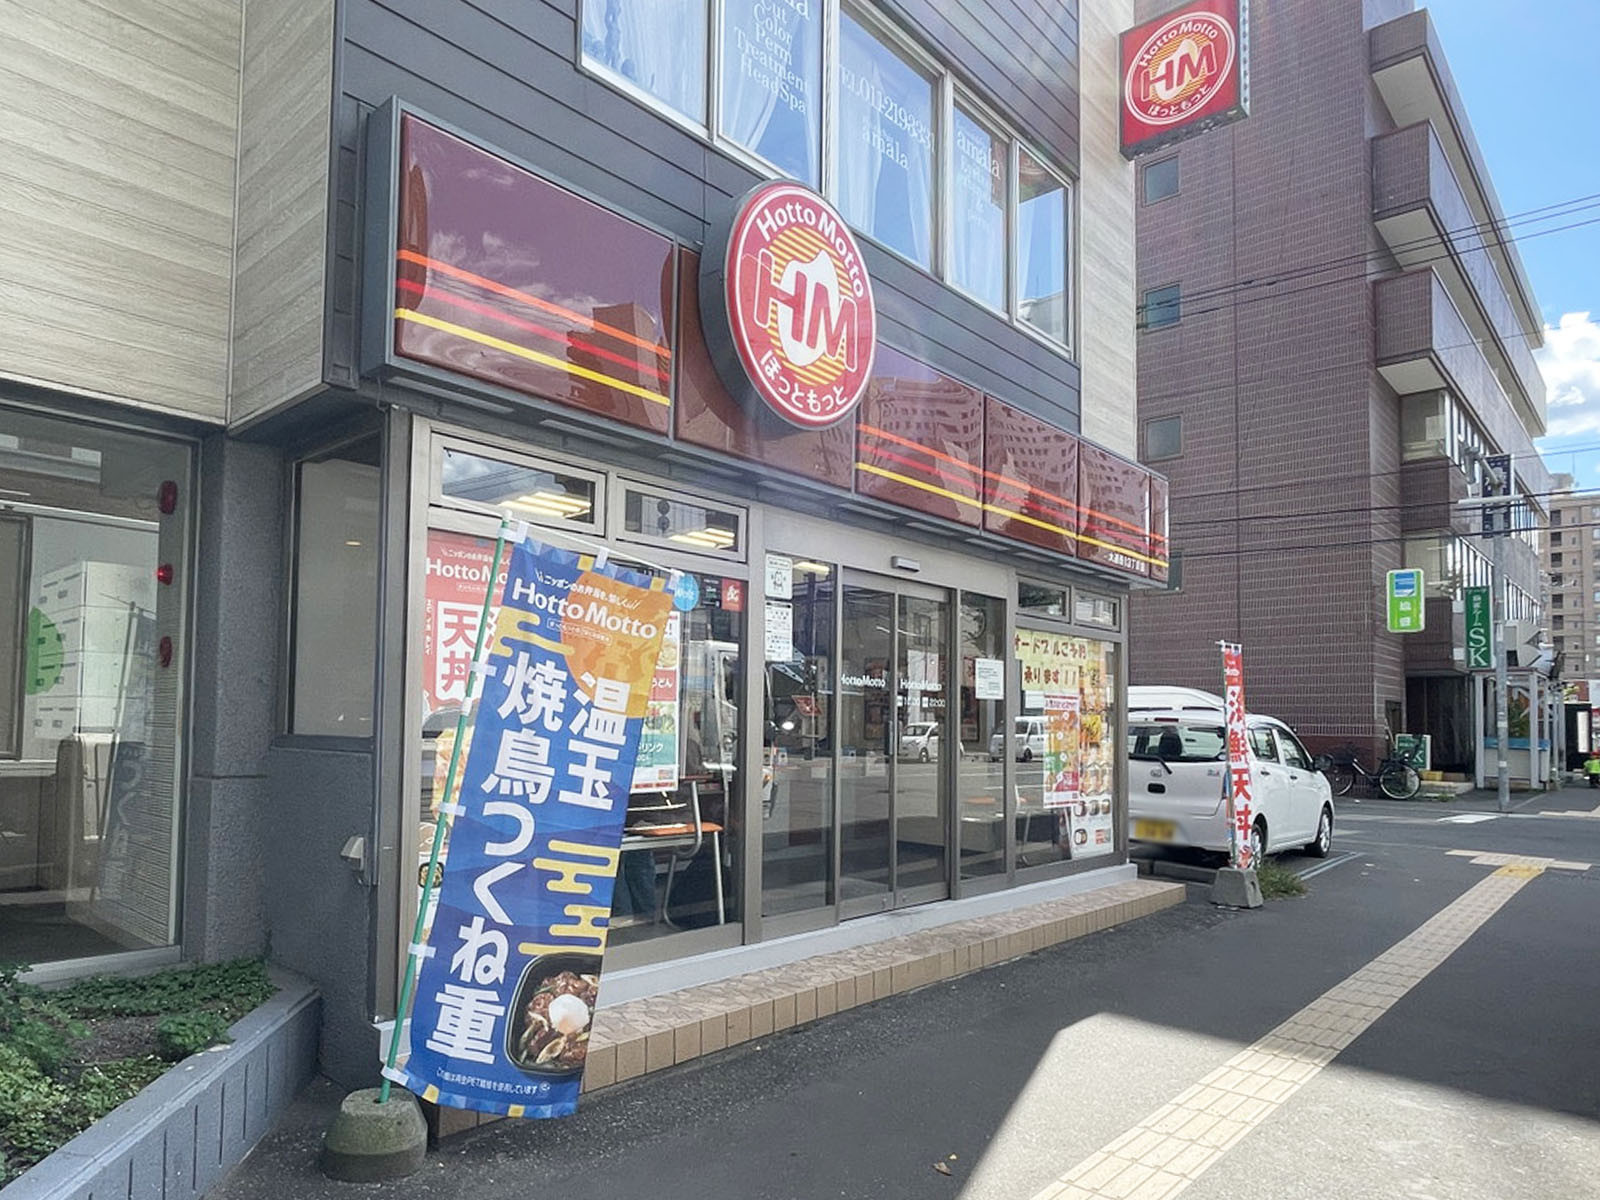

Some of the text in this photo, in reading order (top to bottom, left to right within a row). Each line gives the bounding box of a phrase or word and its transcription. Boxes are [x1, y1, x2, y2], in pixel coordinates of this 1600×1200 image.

[753, 3, 793, 43] Color
[755, 23, 792, 65] Perm
[1138, 21, 1218, 67] Hotto Motto
[734, 27, 808, 94] Treatment
[1140, 41, 1218, 102] HM
[1147, 84, 1211, 117] ほっともっと
[862, 127, 910, 170] amala
[956, 130, 1001, 181] amala
[756, 201, 864, 298] Hotto Motto
[753, 248, 858, 373] HM
[759, 350, 848, 414] ほっともっと
[557, 671, 632, 811] 温玉
[426, 651, 568, 1065] 焼鳥つくね重
